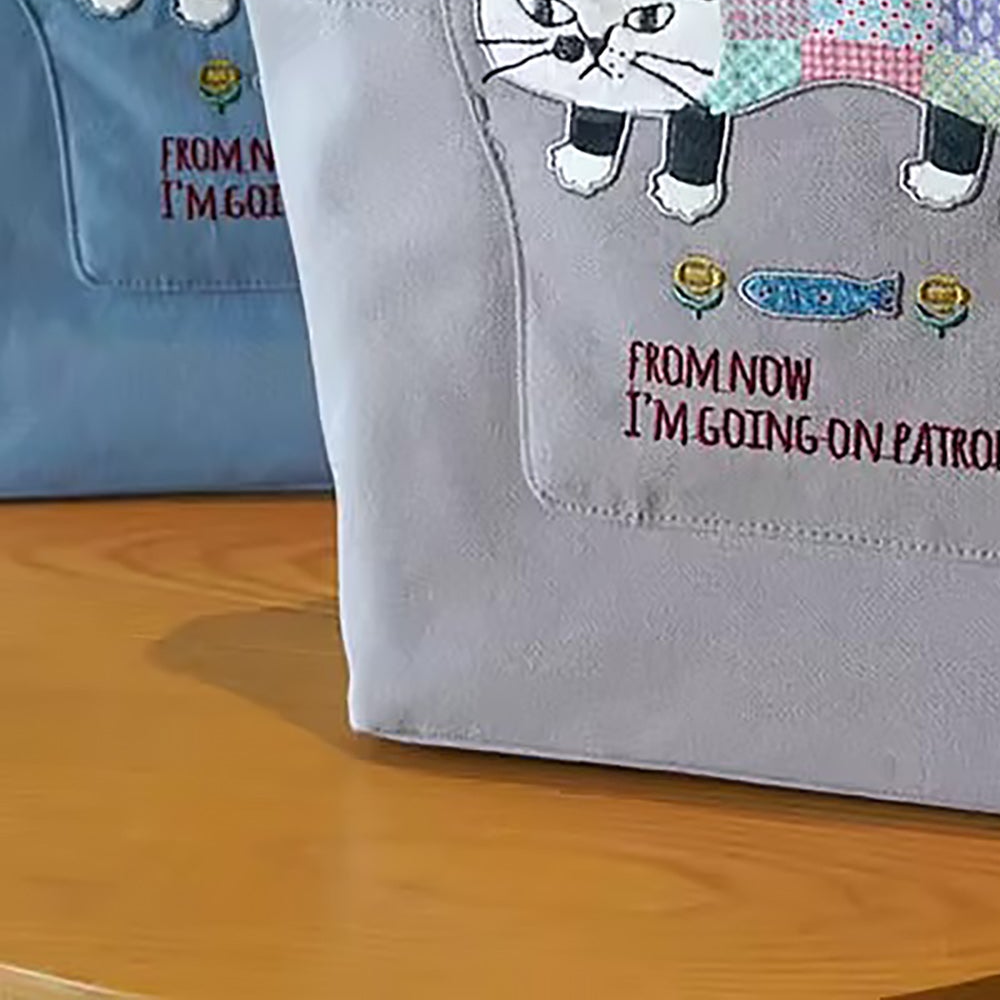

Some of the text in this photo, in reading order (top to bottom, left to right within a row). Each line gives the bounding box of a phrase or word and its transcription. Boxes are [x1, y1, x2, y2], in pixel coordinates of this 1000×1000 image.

[161, 136, 243, 174] FROM
[161, 179, 217, 220] I'M
[628, 341, 812, 400] FROM NOW
[624, 391, 688, 446] I'M
[697, 406, 819, 455] GOING
[827, 417, 882, 463] ON
